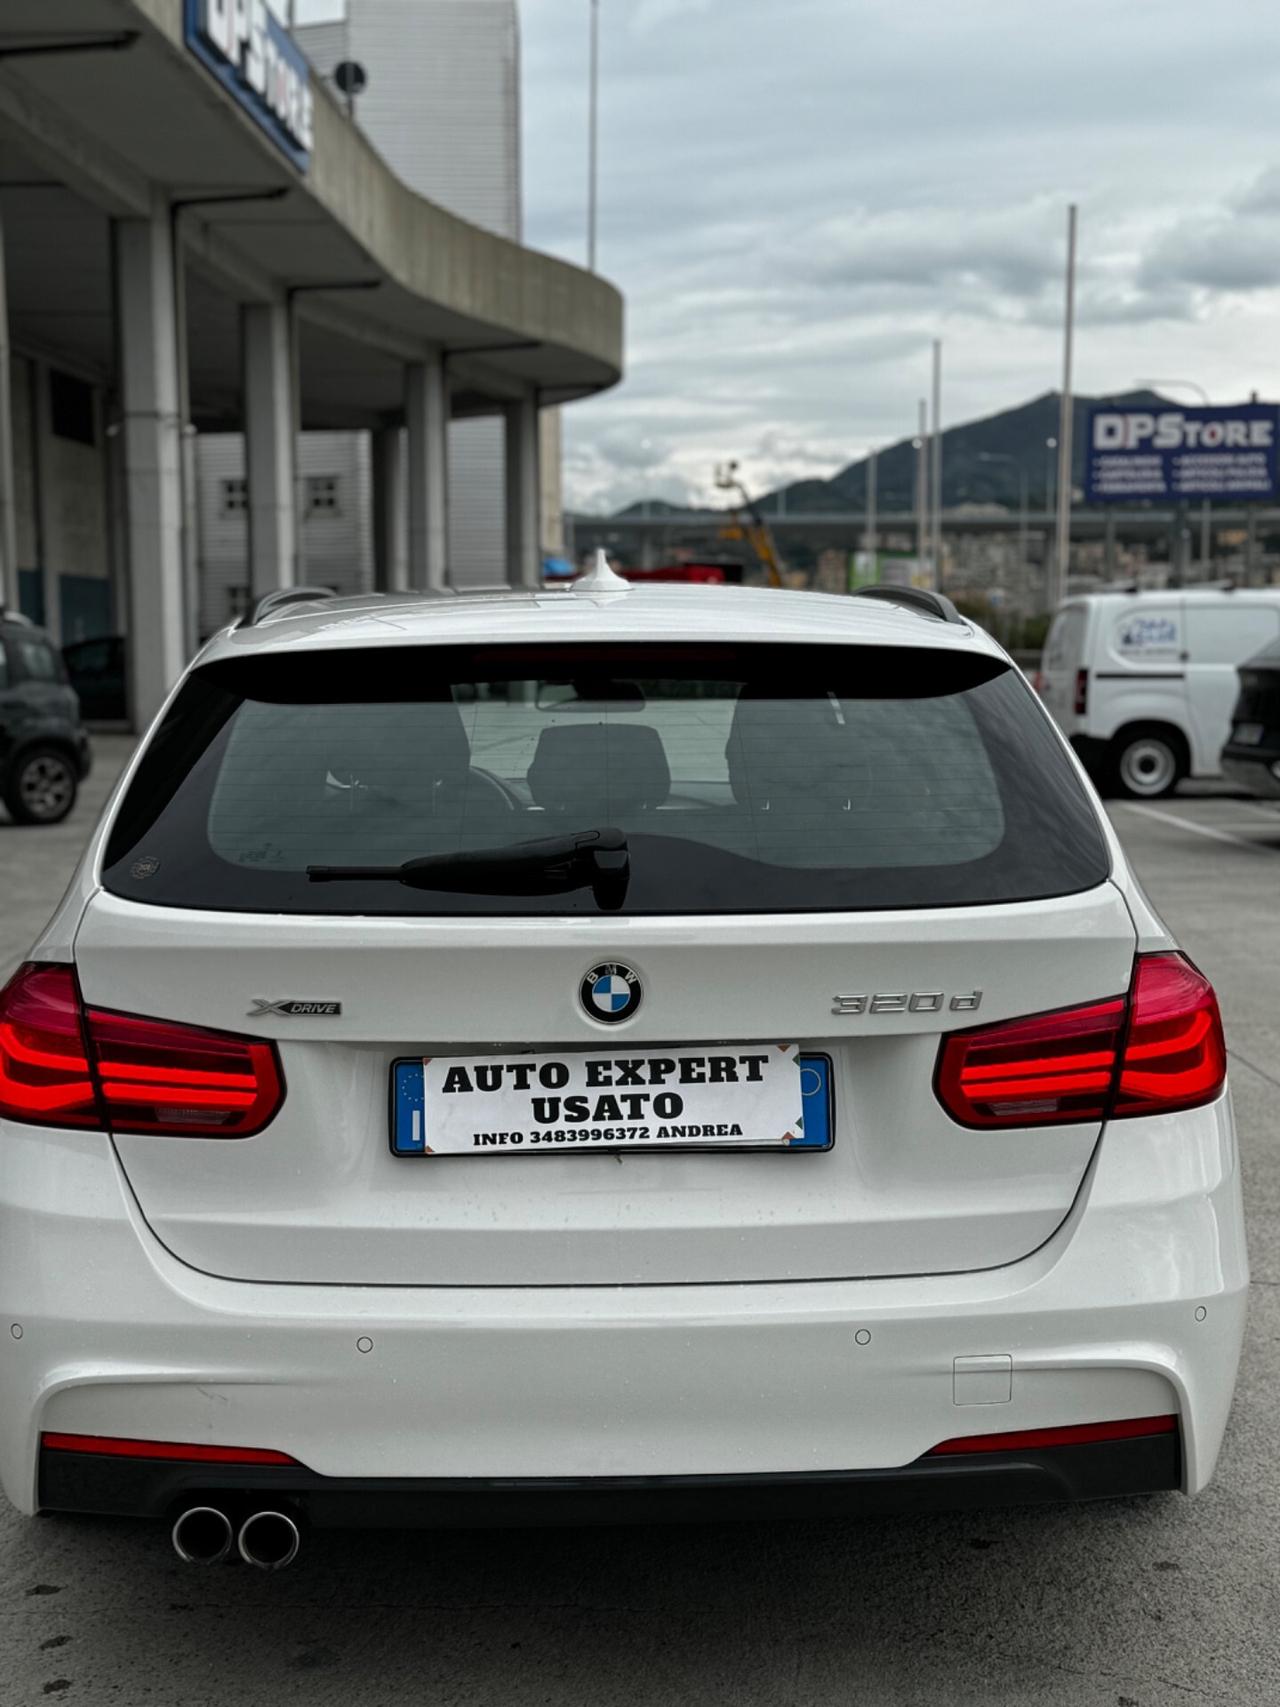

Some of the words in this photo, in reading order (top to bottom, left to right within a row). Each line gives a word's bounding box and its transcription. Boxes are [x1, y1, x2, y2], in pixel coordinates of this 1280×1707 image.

[586, 964, 637, 985] BMW
[831, 990, 983, 1015] 320d
[442, 1062, 570, 1093] AUTO
[585, 1055, 769, 1087] EXPERT
[531, 1092, 683, 1124] USATO
[473, 1131, 524, 1146] INFO
[530, 1127, 650, 1143] 3483996372
[656, 1124, 743, 1139] ANDREA
